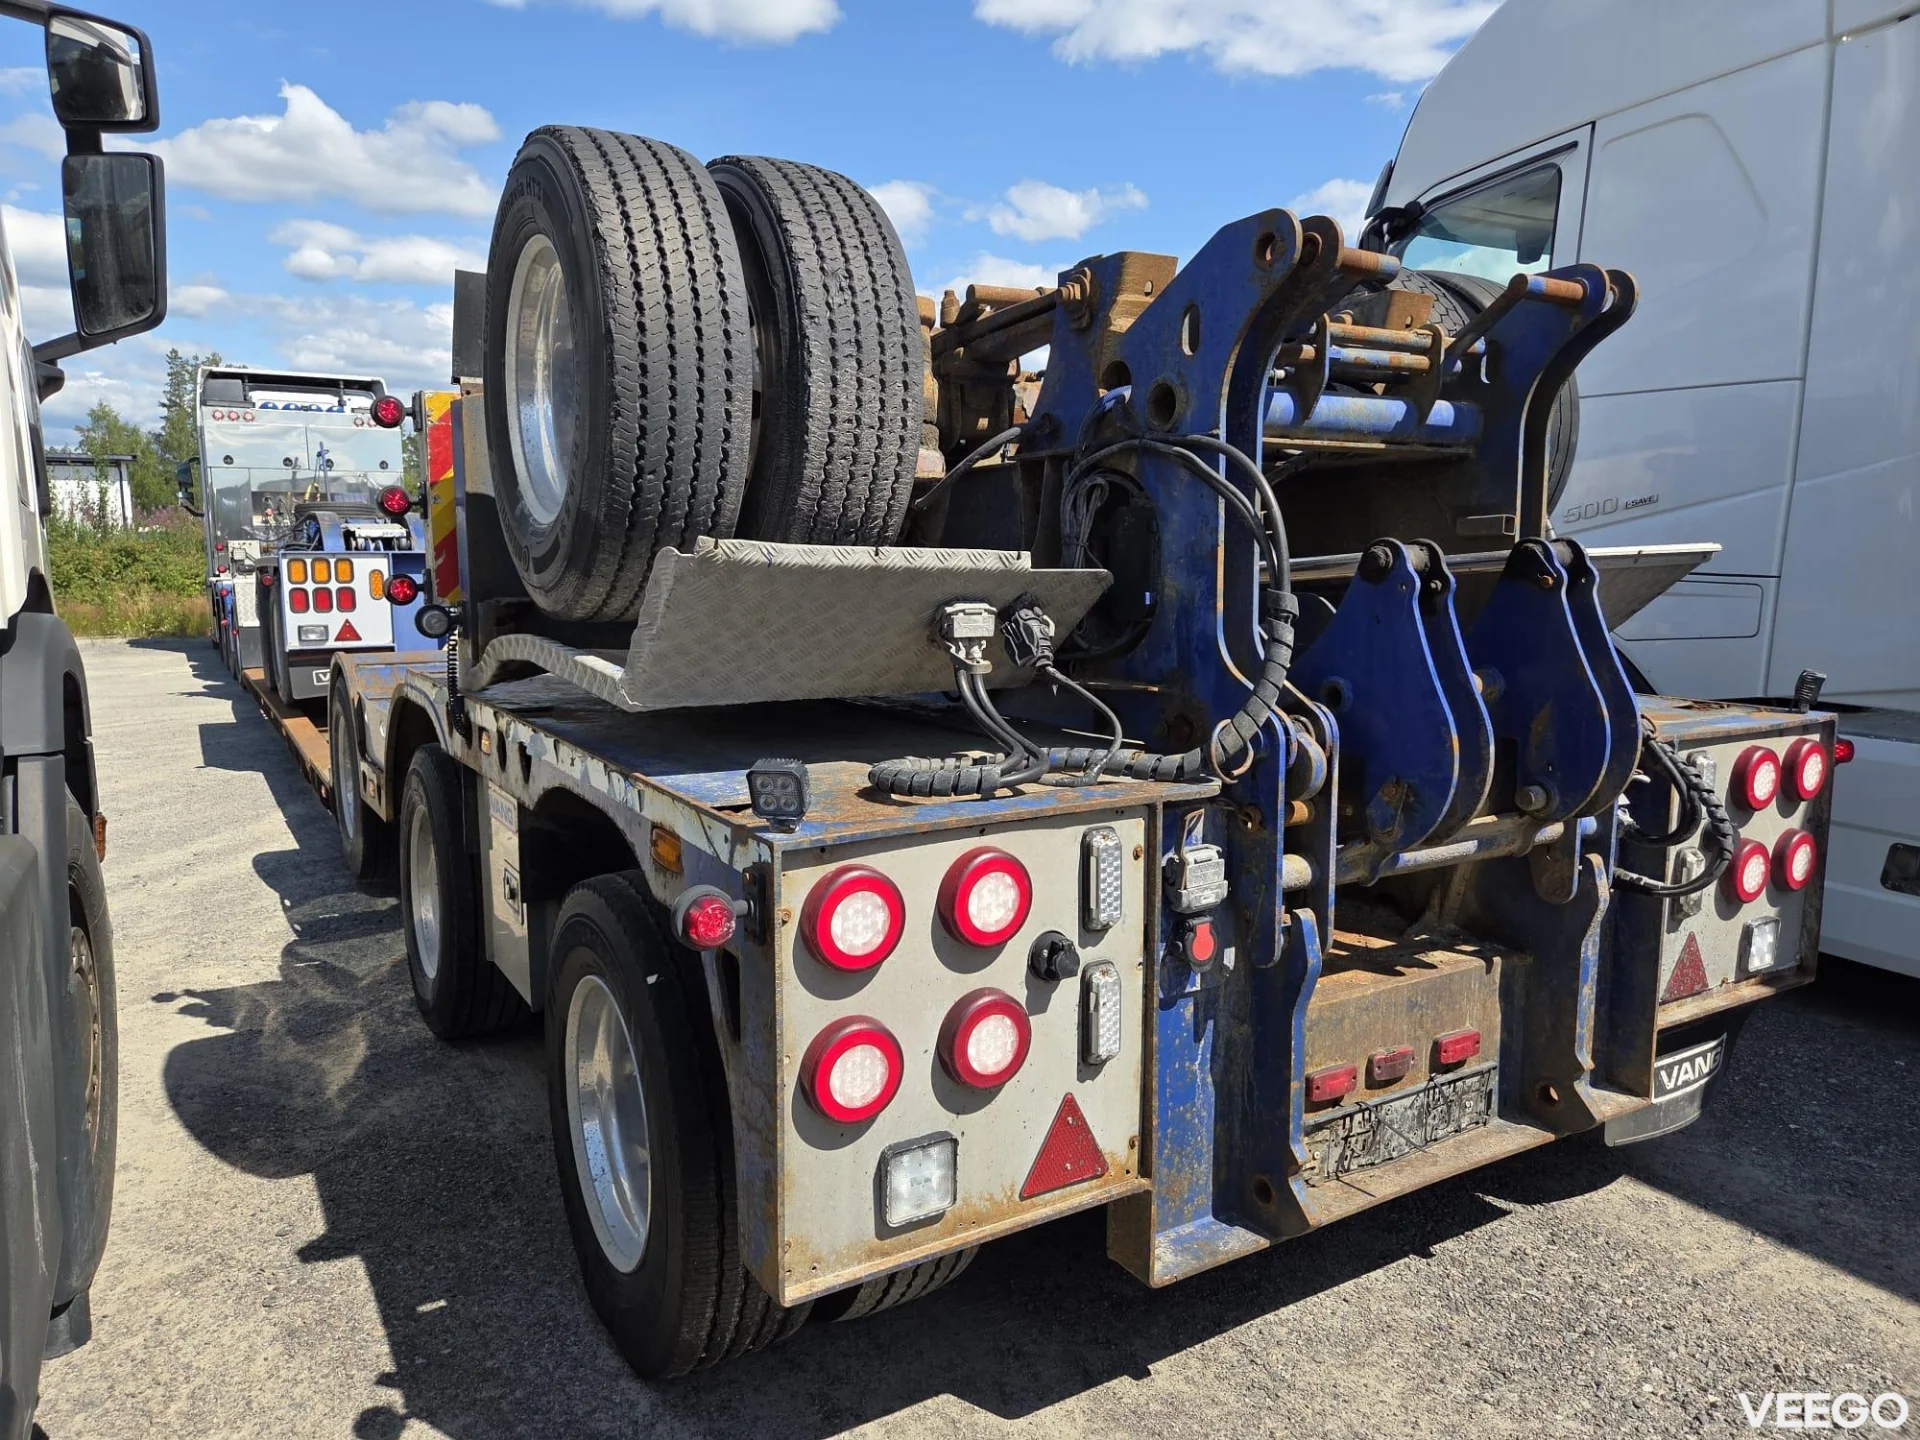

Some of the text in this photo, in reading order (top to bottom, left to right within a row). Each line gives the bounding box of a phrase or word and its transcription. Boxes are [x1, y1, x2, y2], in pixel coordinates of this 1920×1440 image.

[1563, 495, 1656, 524] 500 I-SAVE
[318, 672, 331, 682] V
[1659, 1046, 1722, 1090] VANG
